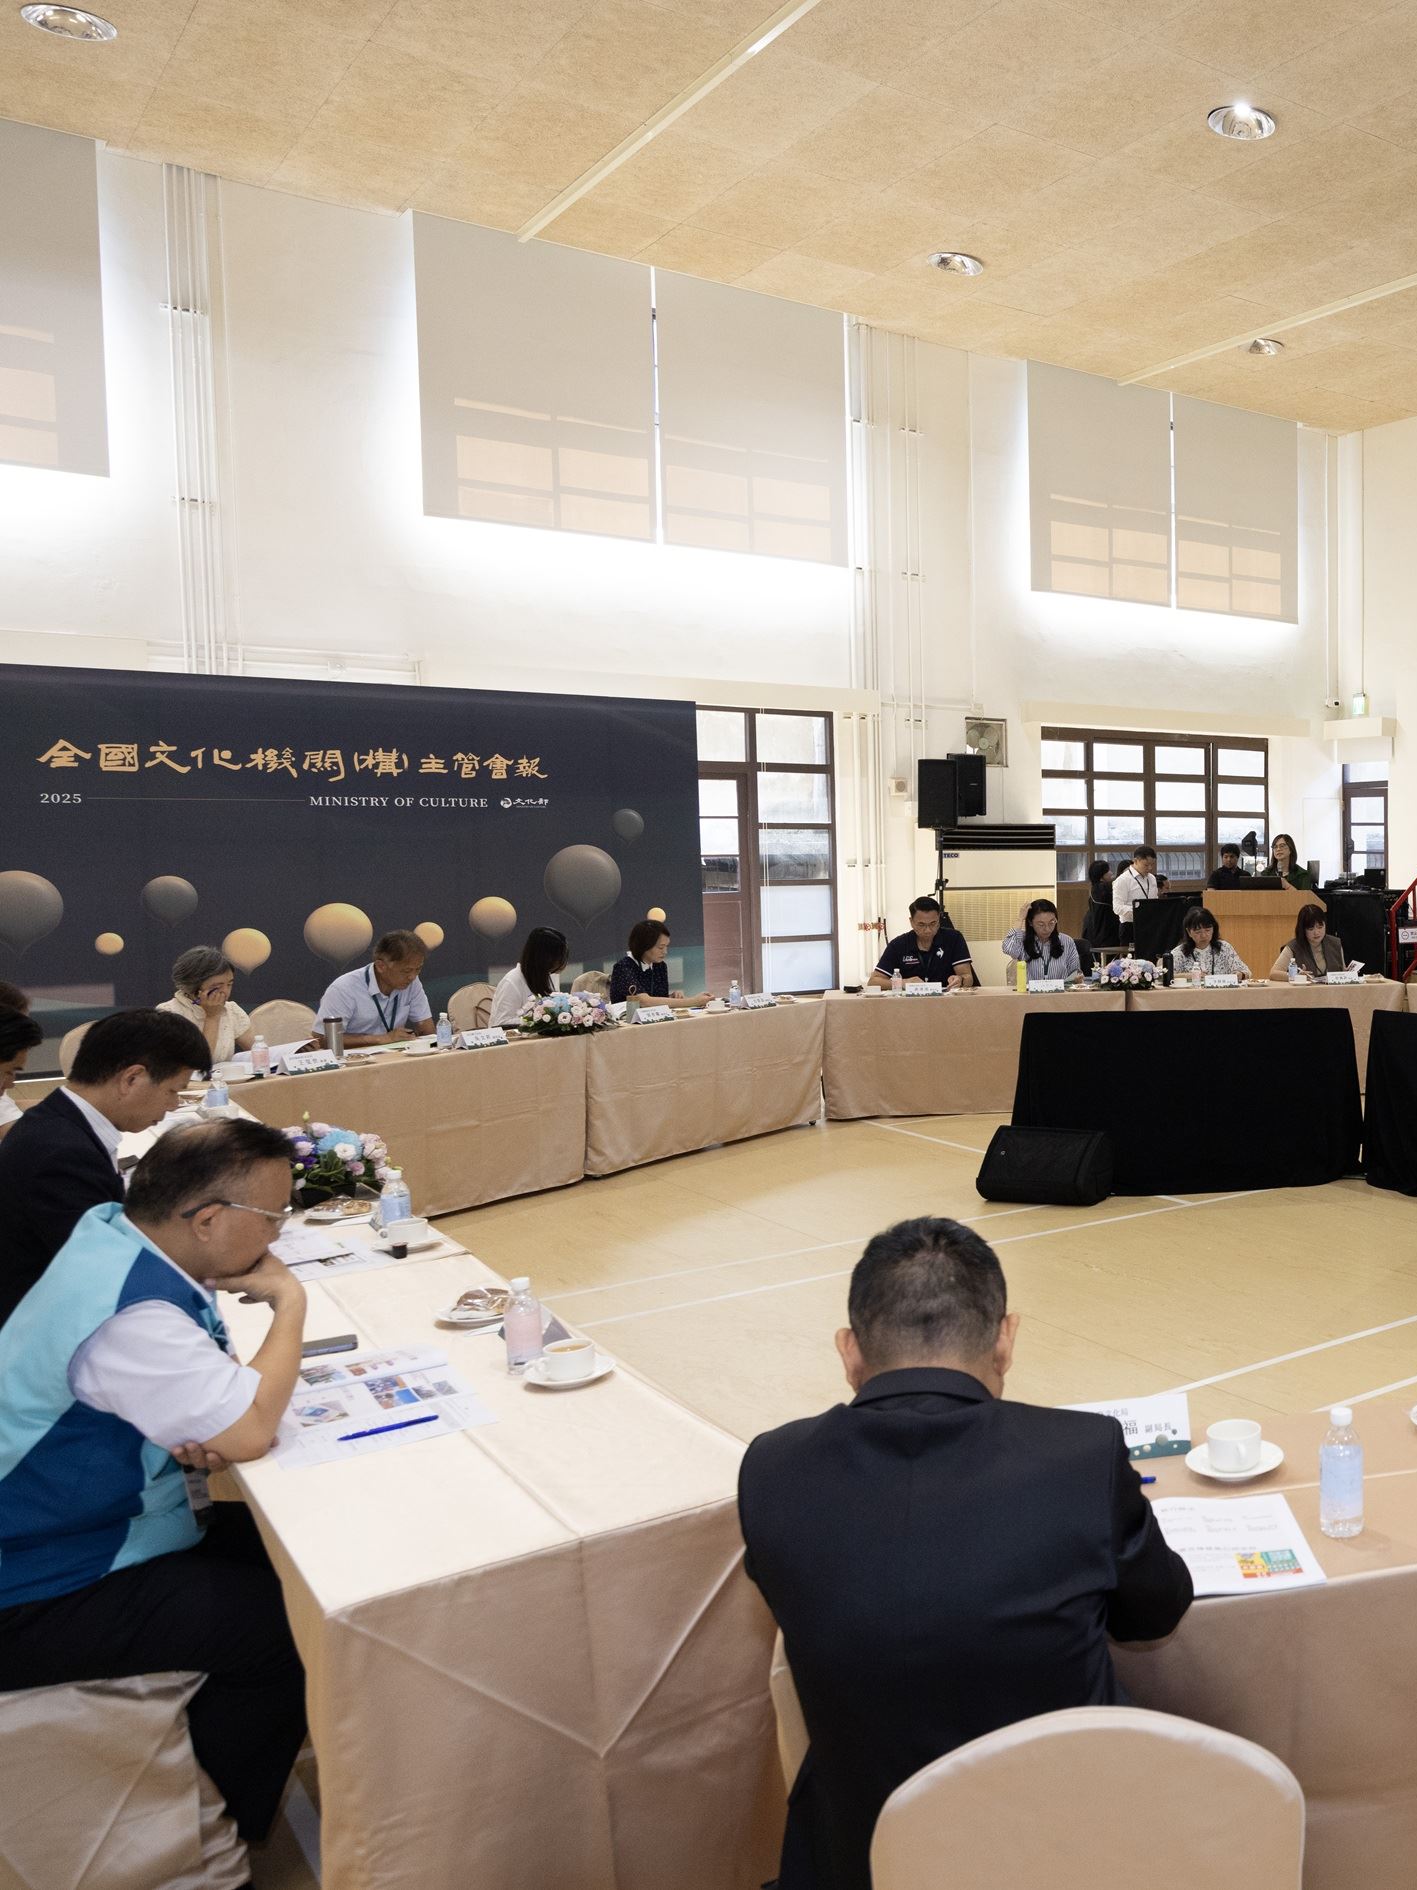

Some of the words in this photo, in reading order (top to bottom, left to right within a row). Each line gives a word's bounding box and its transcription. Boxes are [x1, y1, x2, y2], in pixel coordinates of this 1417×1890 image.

[40, 793, 82, 804] 2025
[310, 796, 389, 807] MINISTRY
[394, 797, 414, 807] OF
[419, 797, 488, 808] CULTURE
[1144, 1422, 1172, 1433] 副局長
